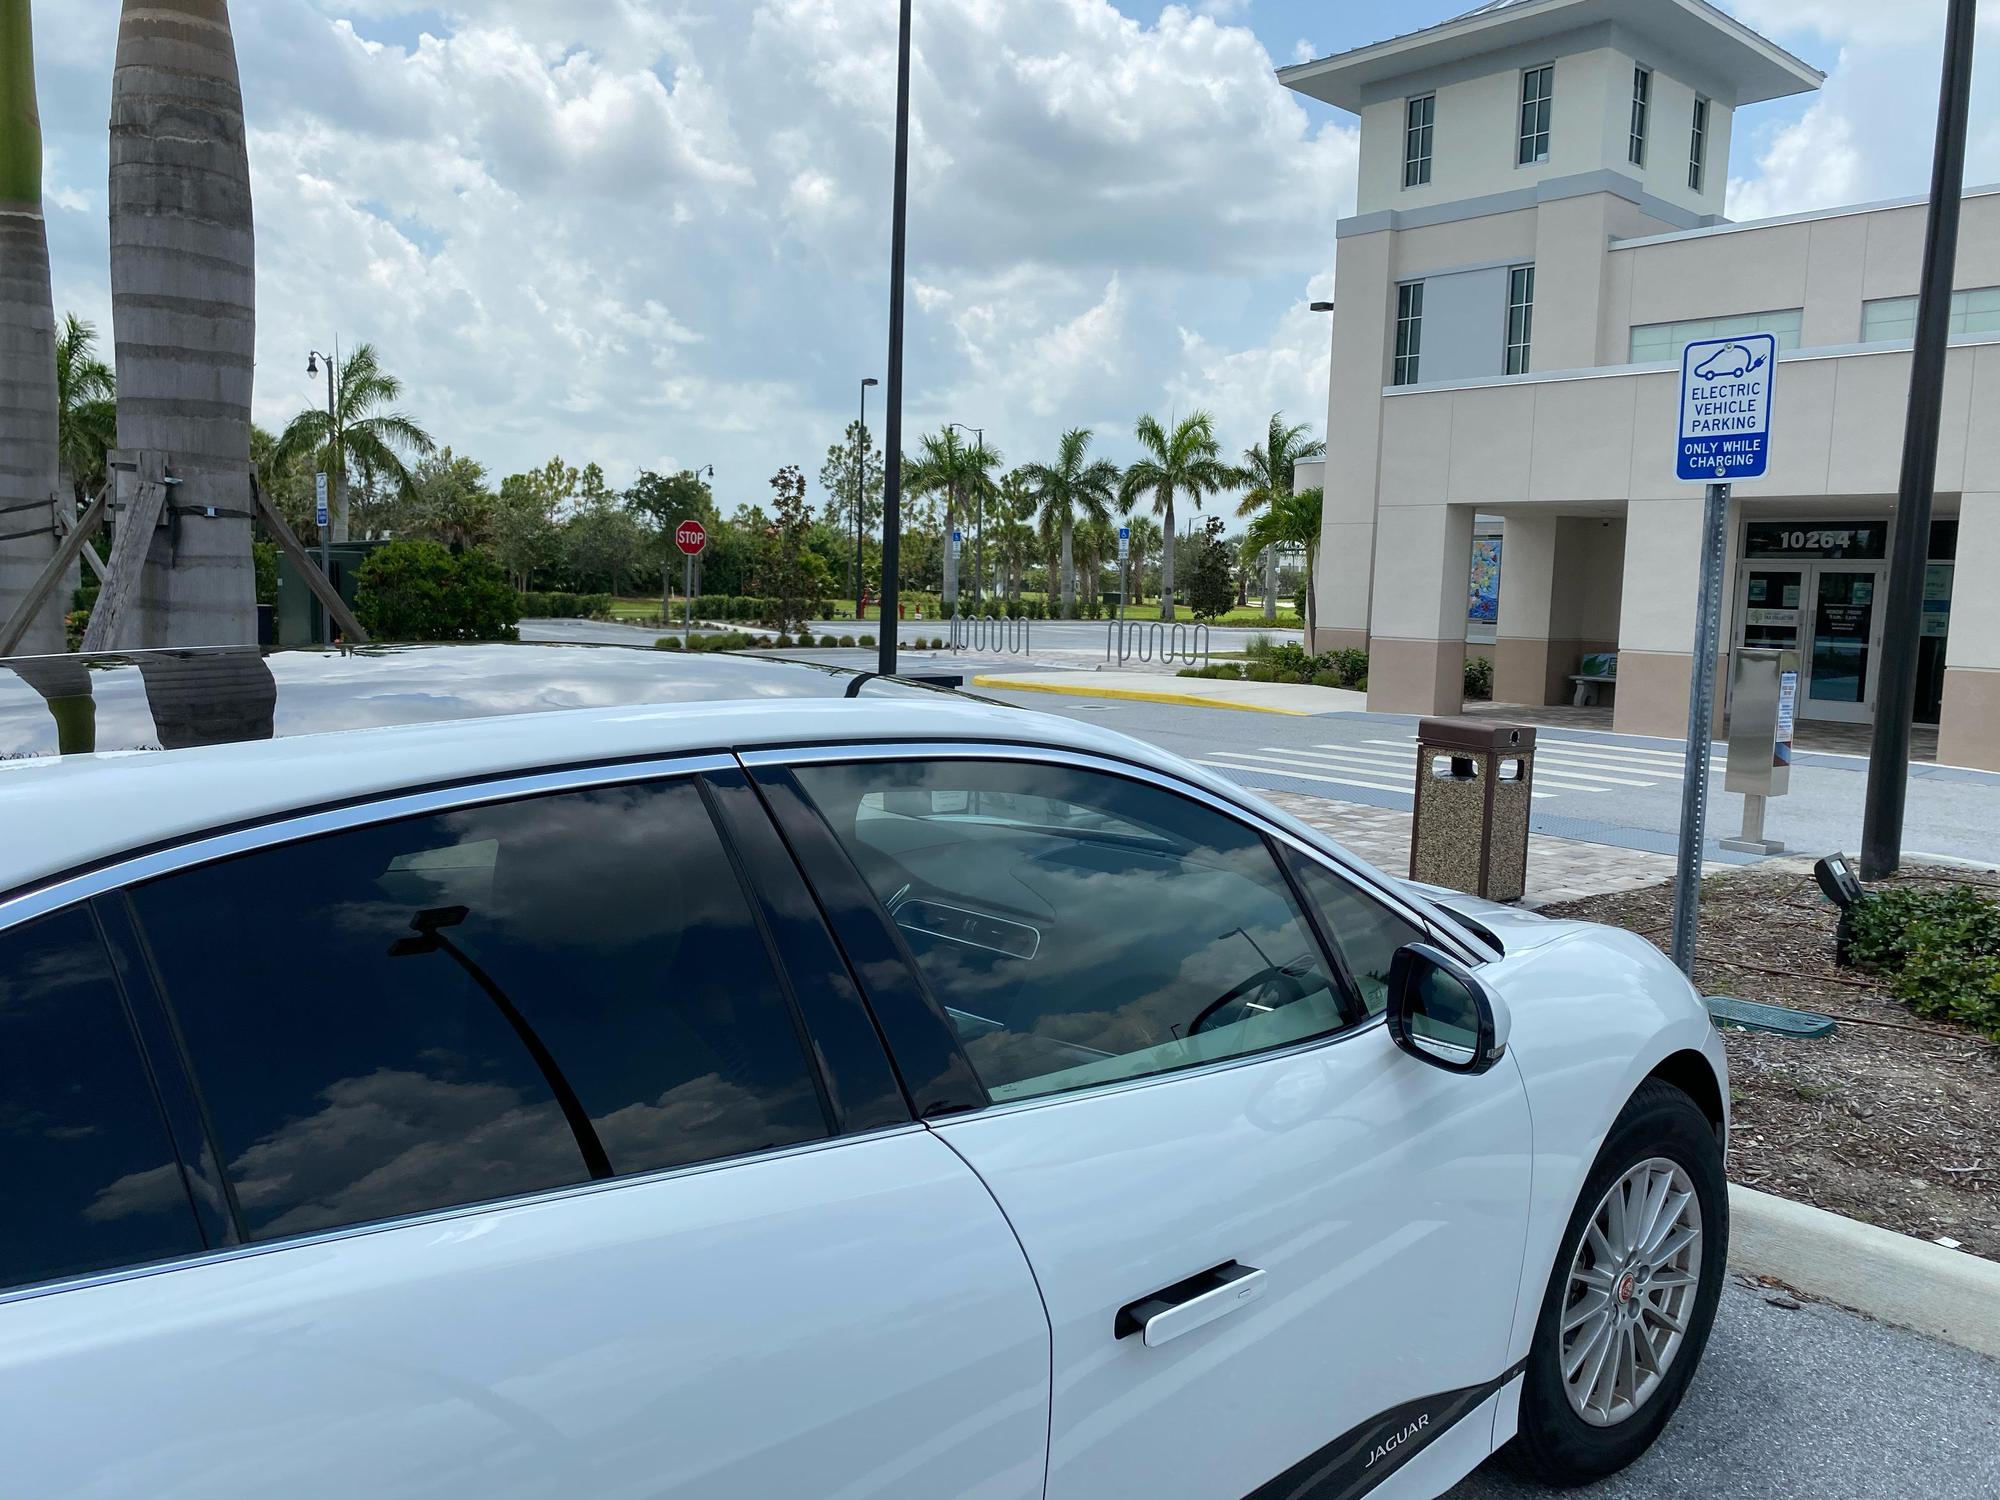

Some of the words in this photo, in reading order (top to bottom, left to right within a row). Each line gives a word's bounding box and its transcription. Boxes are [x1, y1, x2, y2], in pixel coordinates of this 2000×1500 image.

[1692, 382, 1760, 400] ELECTRIC
[1694, 399, 1756, 416] VEHICLE
[1692, 416, 1756, 432] PARKING
[1684, 442, 1719, 455] ONLY
[1723, 439, 1761, 452] WHILE
[1689, 454, 1754, 468] CHARGING
[678, 530, 704, 545] STOP
[1780, 531, 1851, 548] 10264
[1365, 1413, 1430, 1468] JAGUAR
